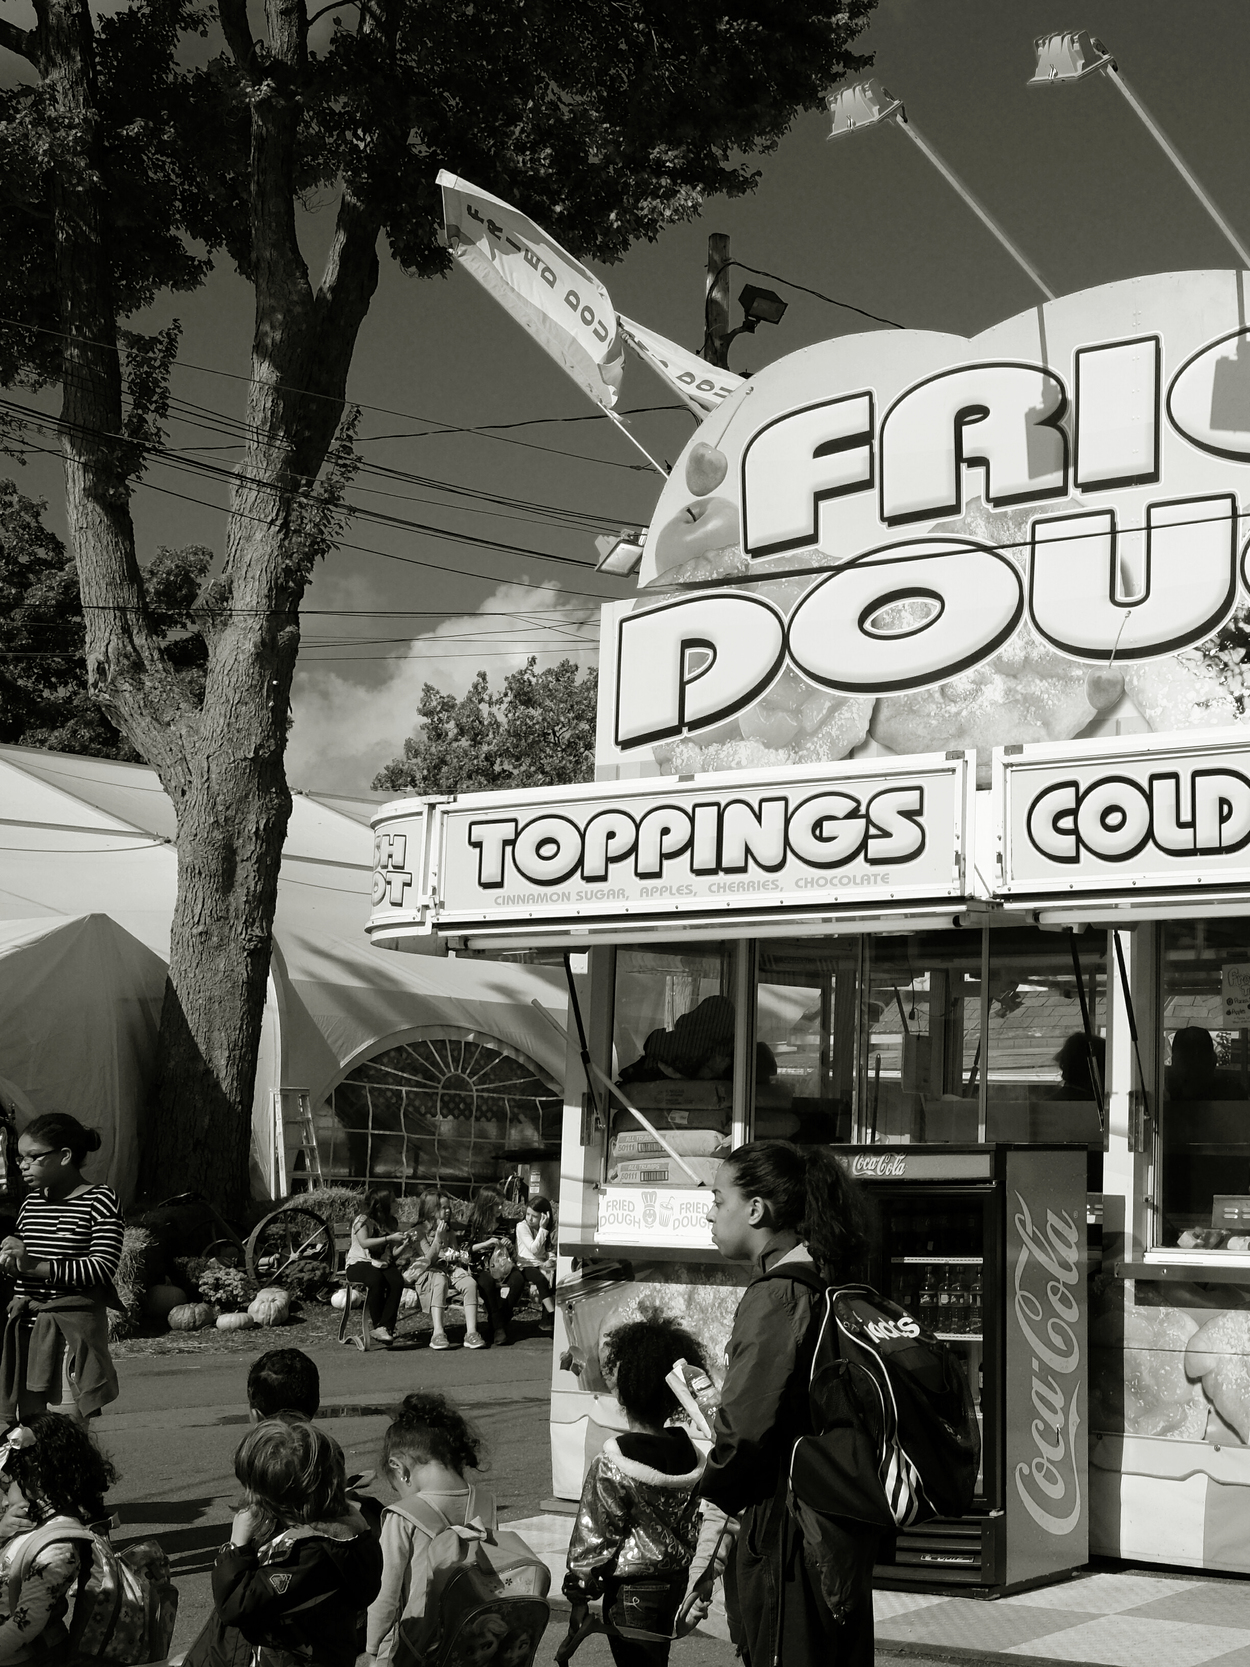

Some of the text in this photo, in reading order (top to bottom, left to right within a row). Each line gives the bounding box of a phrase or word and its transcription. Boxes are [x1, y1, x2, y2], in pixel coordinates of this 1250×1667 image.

[466, 203, 558, 290] FRIED
[467, 785, 926, 888] TOPPINGS
[493, 872, 890, 906] CINNAMON SUGAR, APPLES, CHERRIES, CHOCOLATE
[852, 1152, 908, 1176] Coca-Cola
[600, 1213, 641, 1230] DOUGH
[606, 1199, 710, 1215] FRIED FRIED
[1014, 1189, 1081, 1536] Coca-Cola
